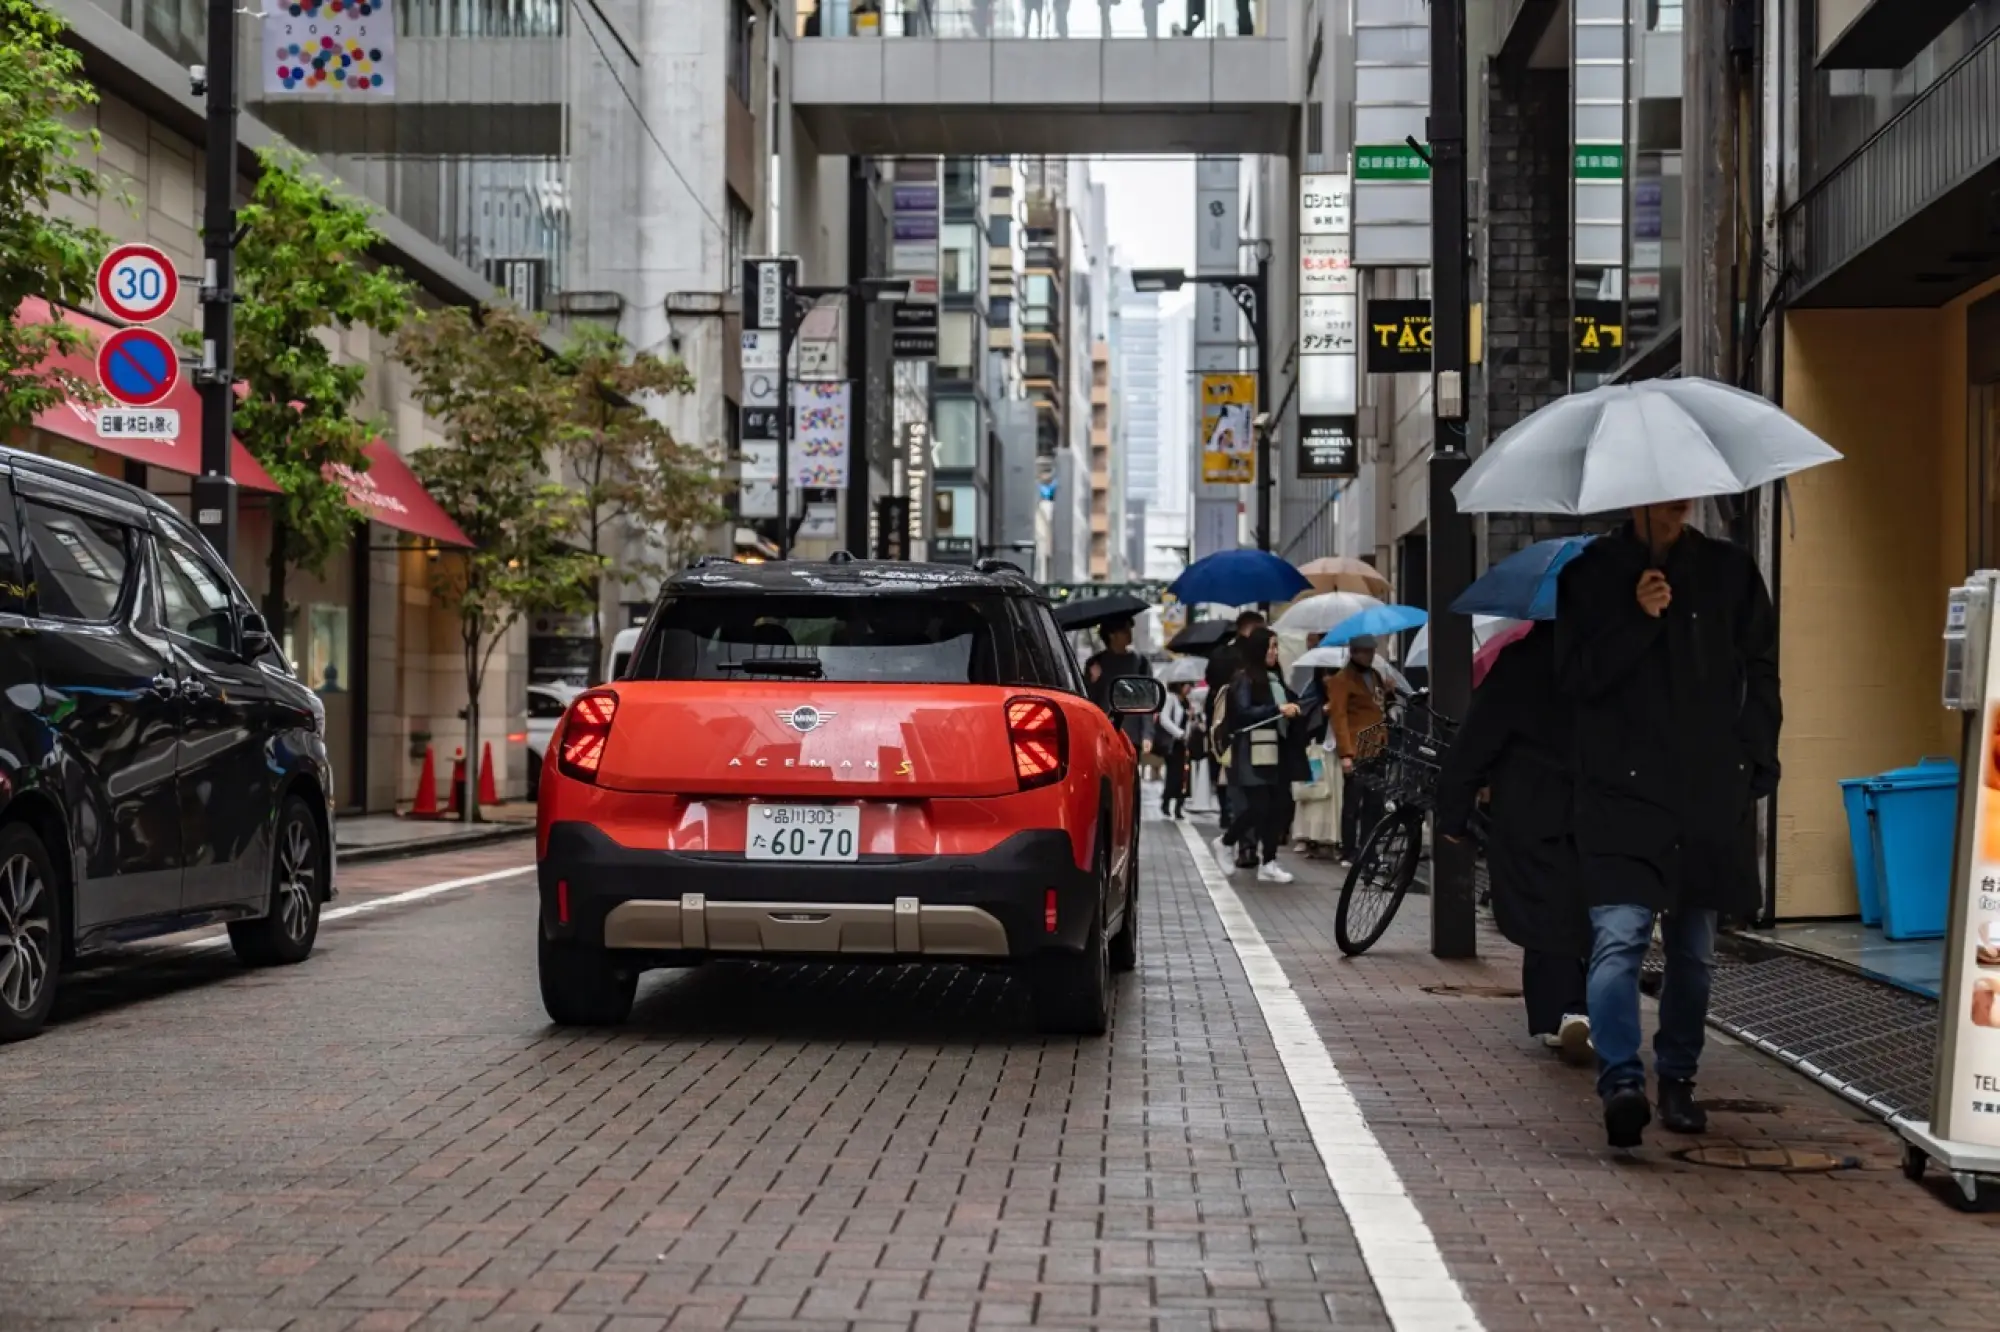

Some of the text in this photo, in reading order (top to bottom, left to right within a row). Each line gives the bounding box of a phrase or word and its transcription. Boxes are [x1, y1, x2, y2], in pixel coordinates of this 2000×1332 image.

[117, 266, 160, 301] 30
[794, 715, 817, 724] MINI
[728, 758, 878, 768] ACEMAN
[771, 828, 853, 857] 60-70
